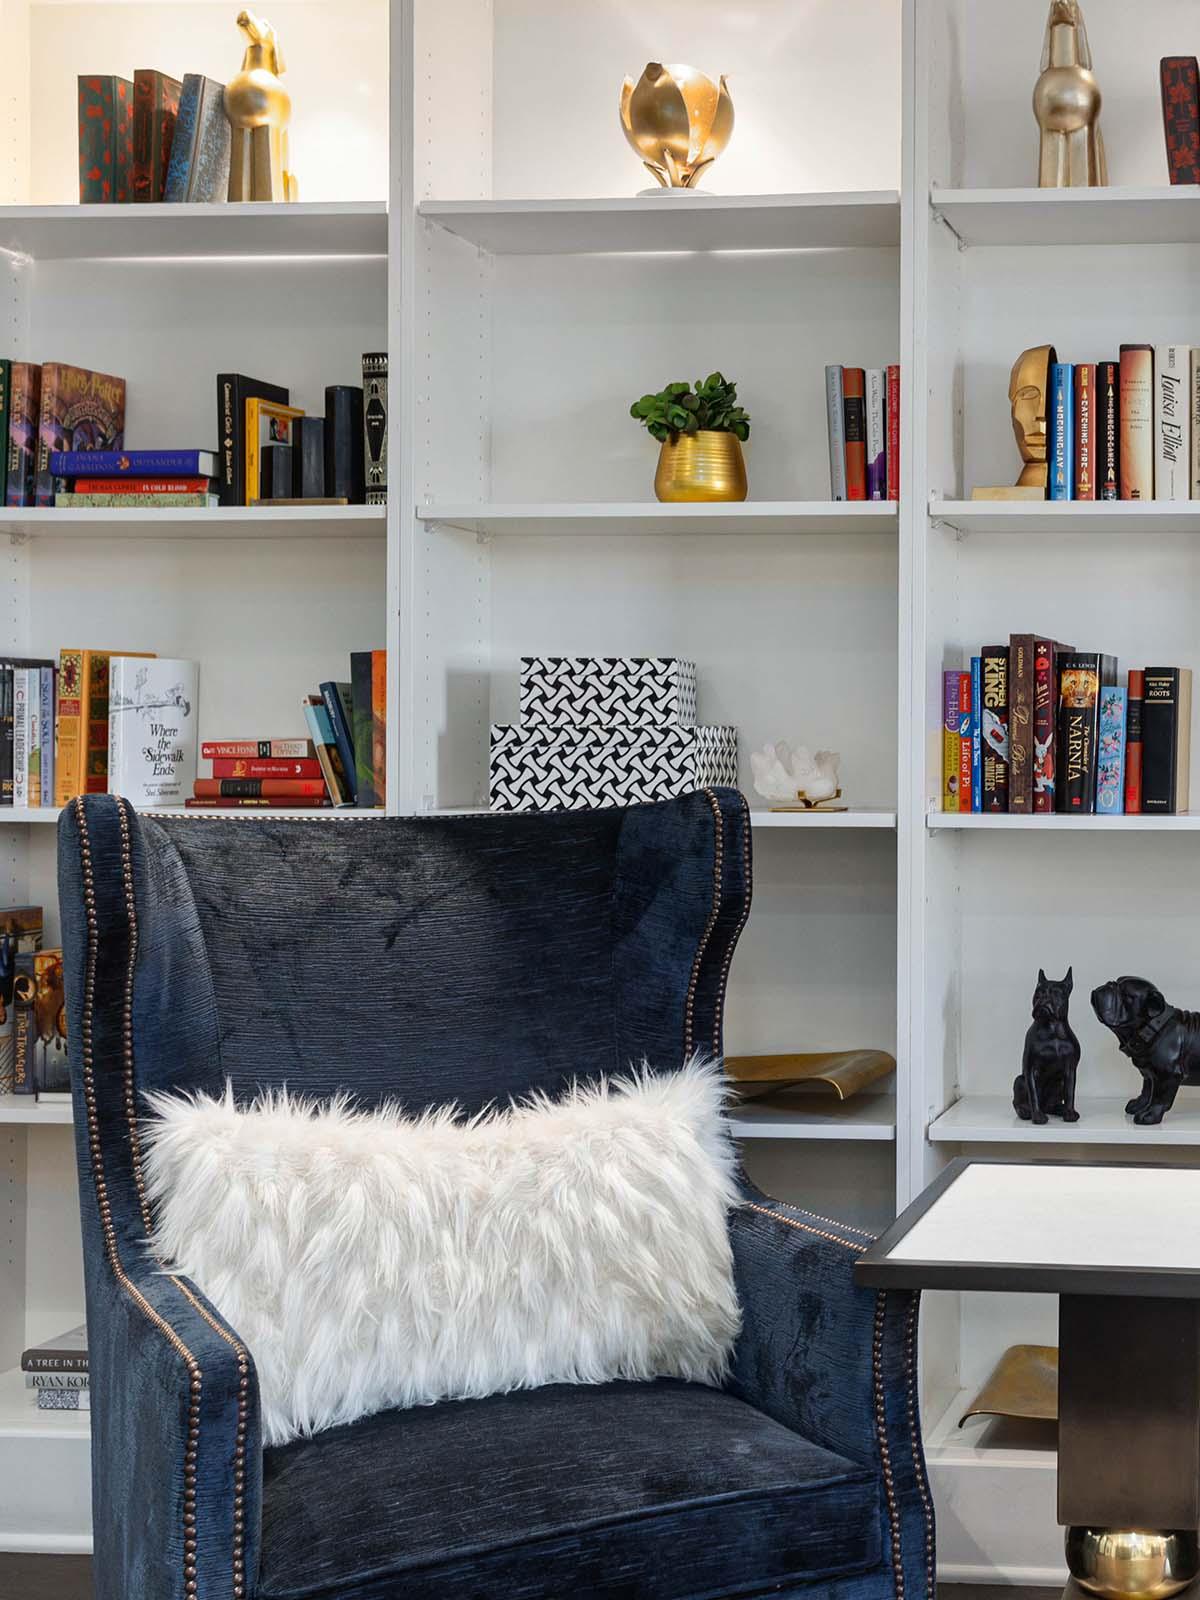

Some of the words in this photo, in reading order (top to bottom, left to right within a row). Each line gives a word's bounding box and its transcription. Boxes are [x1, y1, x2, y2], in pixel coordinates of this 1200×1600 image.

[1056, 406, 1064, 468] MOCKINGJAY
[1162, 421, 1182, 462] Elliott
[1080, 448, 1088, 468] FIRE
[984, 657, 999, 708] KING
[998, 657, 1006, 707] STEPHEN
[950, 688, 958, 699] The
[16, 702, 24, 727] PRIMAL
[946, 701, 959, 726] Help
[150, 724, 178, 737] Where
[16, 729, 24, 772] LEADERSHIP
[158, 737, 171, 751] the
[216, 745, 236, 755] VINCE
[962, 742, 970, 762] Life
[1068, 716, 1083, 781] NARNIA
[142, 747, 184, 764] Sidewalk
[1012, 744, 1026, 776] Bride
[152, 763, 175, 776] Ends
[962, 763, 970, 774] of
[984, 756, 995, 792] SUMMERS
[995, 763, 1004, 784] BILLY
[1083, 766, 1089, 774] of
[962, 777, 970, 788] Pi
[16, 1011, 27, 1035] TIME
[15, 1035, 28, 1084] TRAVELERS
[27, 1360, 33, 1368] A
[36, 1360, 60, 1368] TREE
[63, 1360, 73, 1368] IN
[32, 1375, 64, 1387] RYAN
